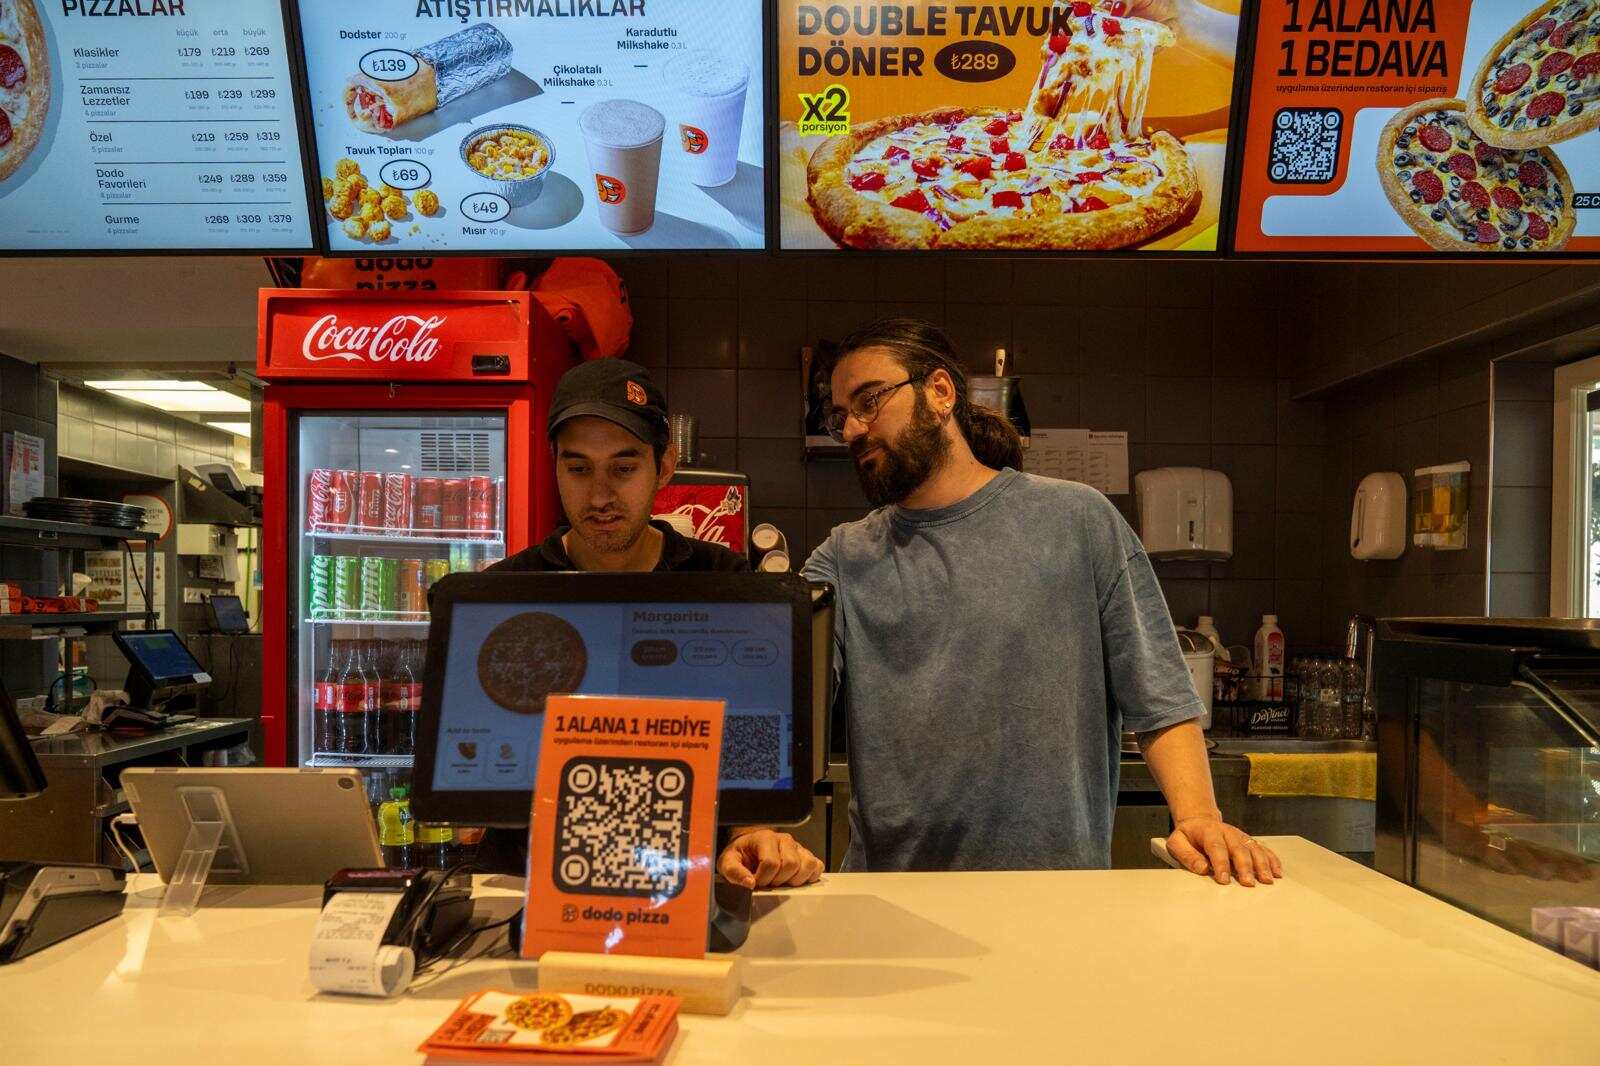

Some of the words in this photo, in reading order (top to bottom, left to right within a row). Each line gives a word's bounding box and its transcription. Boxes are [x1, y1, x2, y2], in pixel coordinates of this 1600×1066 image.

[798, 6, 946, 36] DOUBLE
[954, 6, 1073, 36] TAVUK
[1283, 0, 1302, 32] 1
[1308, 0, 1436, 33] ALANA
[176, 28, 199, 37] küçük
[243, 28, 266, 37] büyük
[340, 30, 381, 39] Dodster
[384, 31, 399, 39] 200
[626, 27, 677, 37] Karadutlu
[617, 40, 669, 50] Milkshake
[73, 47, 120, 57] Klasikler
[177, 47, 202, 57] ₺179
[211, 47, 236, 57] ₺219
[244, 46, 270, 56] ₺269
[798, 40, 924, 76] DÖNER
[950, 53, 999, 70] ₺289
[1277, 40, 1298, 76] 1
[1305, 40, 1448, 77] BEDAVA
[372, 59, 406, 72] ₺139
[553, 65, 602, 76] Çikolatalı
[543, 77, 595, 87] Milkshake
[80, 85, 130, 95] Zamansız
[1276, 83, 1320, 93] uygulama
[1321, 83, 1364, 93] üzerinden
[1365, 84, 1404, 93] restoran
[185, 90, 209, 100] ₺199
[217, 90, 243, 99] ₺239
[250, 89, 276, 99] ₺299
[83, 96, 130, 106] Lezzetler
[804, 88, 847, 122] x2
[802, 123, 847, 134] porsiyon
[89, 131, 113, 142] Özel
[192, 133, 215, 142] ₺219
[224, 132, 249, 141] ₺259
[256, 132, 280, 141] ₺319
[346, 146, 376, 155] Tavuk
[377, 146, 412, 157] Topları
[96, 169, 124, 178] Dodo
[198, 174, 223, 183] ₺249
[230, 174, 255, 183] ₺289
[262, 173, 287, 183] ₺359
[392, 169, 419, 181] ₺69
[98, 179, 147, 189] Favorileri
[1575, 195, 1591, 206] 25
[472, 201, 499, 213] ₺49
[105, 215, 140, 224] Gurme
[204, 215, 230, 224] ₺269
[236, 215, 261, 224] ₺309
[268, 214, 292, 223] ₺379
[462, 226, 487, 236] Mısır
[302, 314, 447, 362] Coca-Cola
[632, 610, 709, 625] Margarita
[555, 715, 565, 731] 1
[568, 716, 626, 734] ALANA
[630, 718, 640, 735] 1
[646, 715, 710, 737] HEDİYE
[582, 906, 623, 922] dodo
[626, 908, 670, 925] pizza
